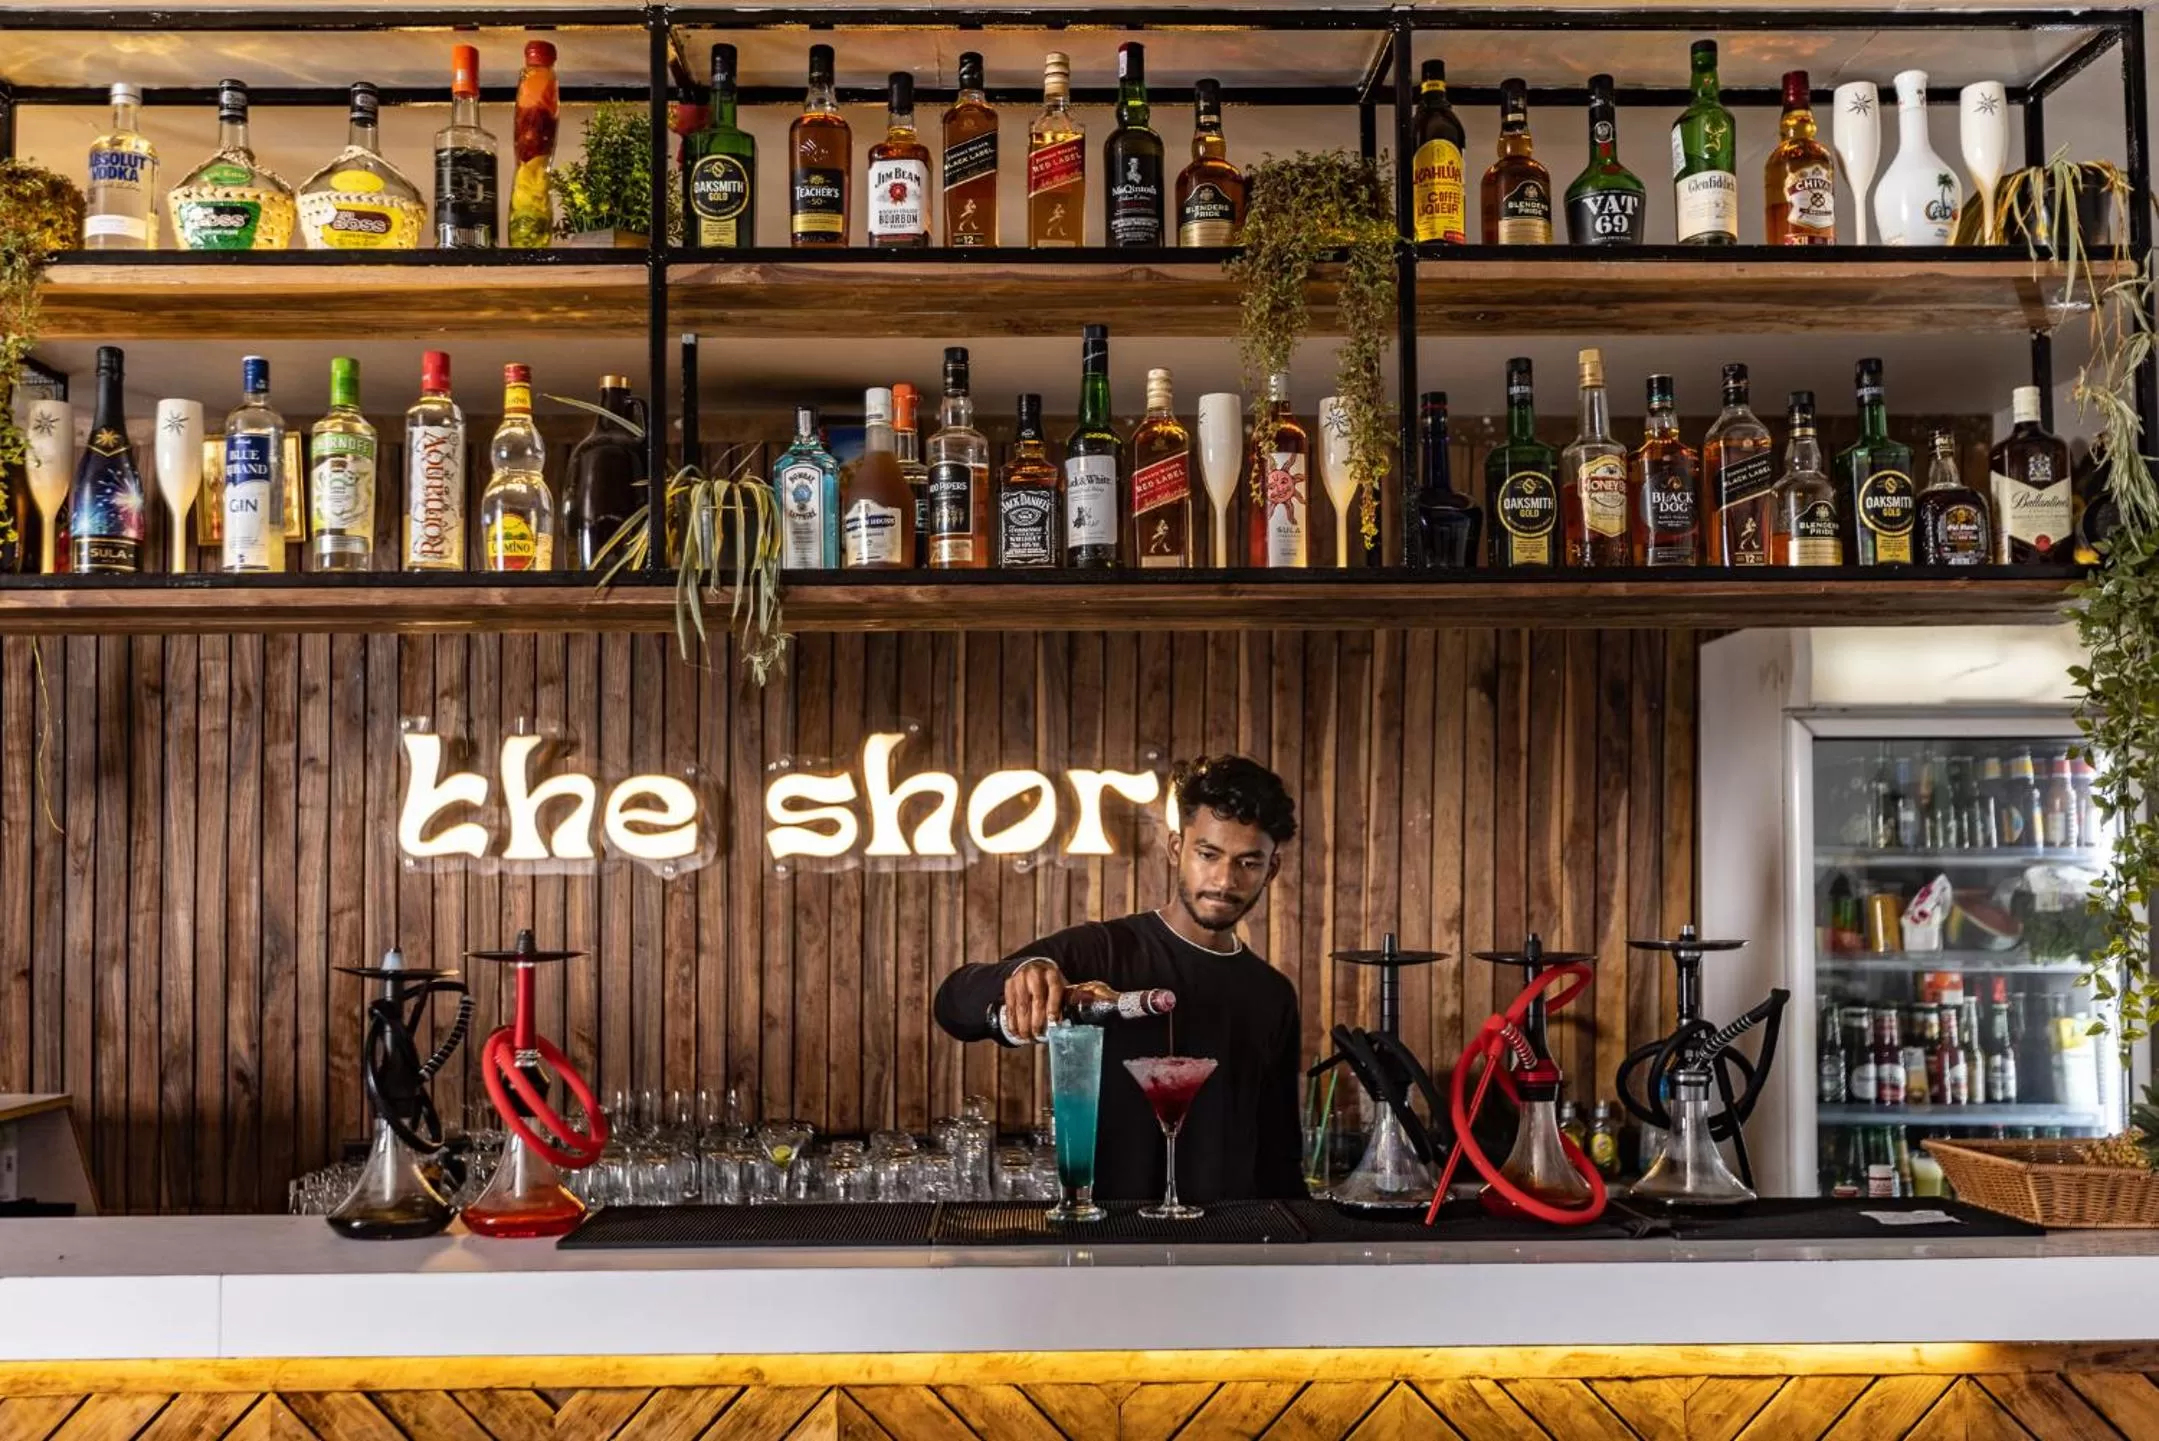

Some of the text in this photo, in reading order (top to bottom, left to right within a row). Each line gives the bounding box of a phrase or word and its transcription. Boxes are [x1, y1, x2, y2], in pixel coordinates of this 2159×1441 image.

[91, 166, 139, 183] VODKA
[894, 167, 921, 187] BEAM
[694, 180, 743, 194] OAKSMITH
[1795, 178, 1831, 191] CHIVA
[708, 192, 728, 202] GOLD
[795, 186, 840, 200] TEACHER'S
[1582, 195, 1637, 215] VAT
[879, 213, 918, 225] BOURBON
[1594, 215, 1628, 233] 69
[963, 235, 975, 245] 12
[230, 450, 260, 460] BLUE
[940, 482, 967, 491] PIPERS
[1136, 470, 1185, 493] RED LABEL
[1503, 497, 1553, 510] OAKSMITH
[1651, 492, 1693, 503] BLACK
[230, 499, 258, 512] GIN
[1659, 502, 1687, 512] DOG
[1520, 509, 1539, 518] GOLD
[90, 549, 127, 559] SULA
[1745, 554, 1756, 564] 12
[400, 732, 1181, 860] the shor
